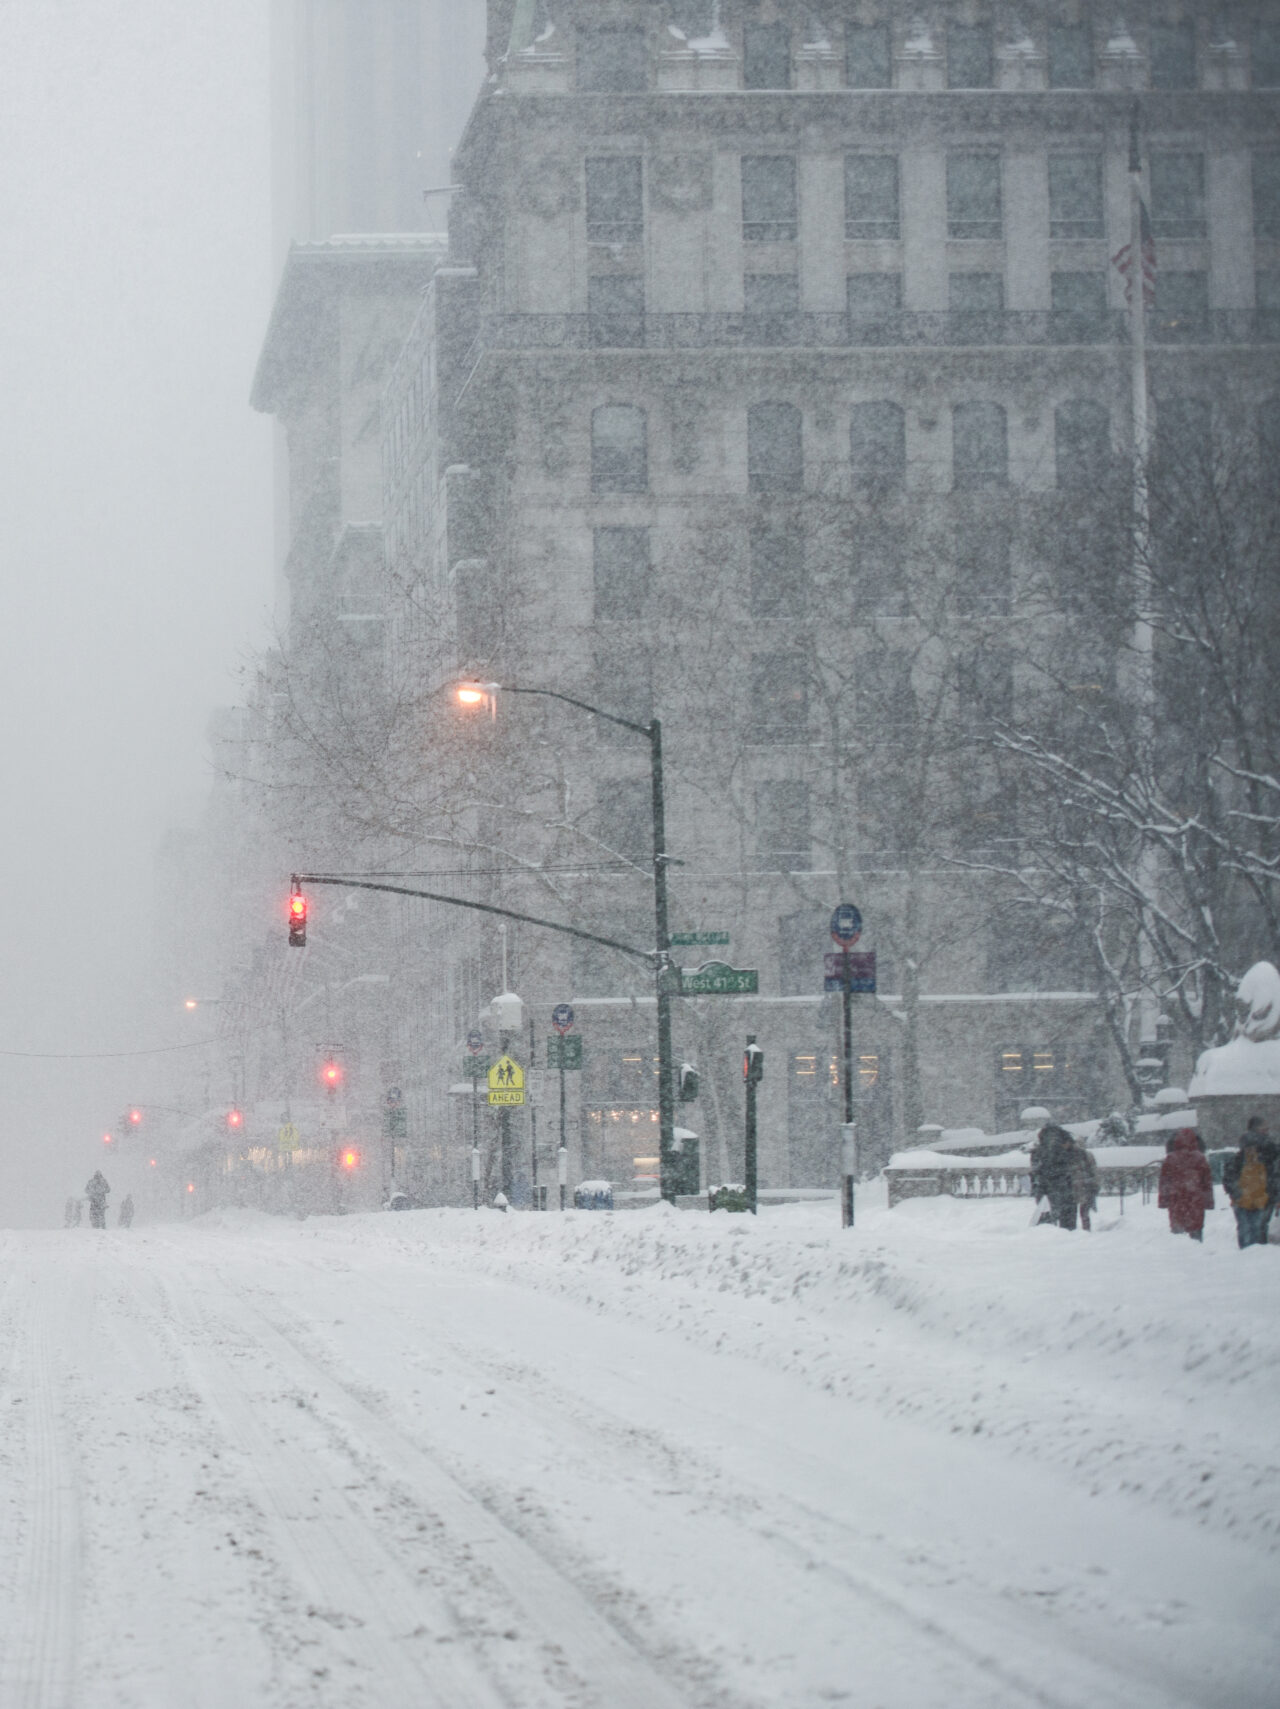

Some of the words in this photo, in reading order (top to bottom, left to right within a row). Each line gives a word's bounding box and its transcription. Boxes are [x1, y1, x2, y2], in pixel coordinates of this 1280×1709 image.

[682, 977, 711, 989] West
[737, 976, 751, 988] St
[492, 1093, 521, 1102] AHEAD
